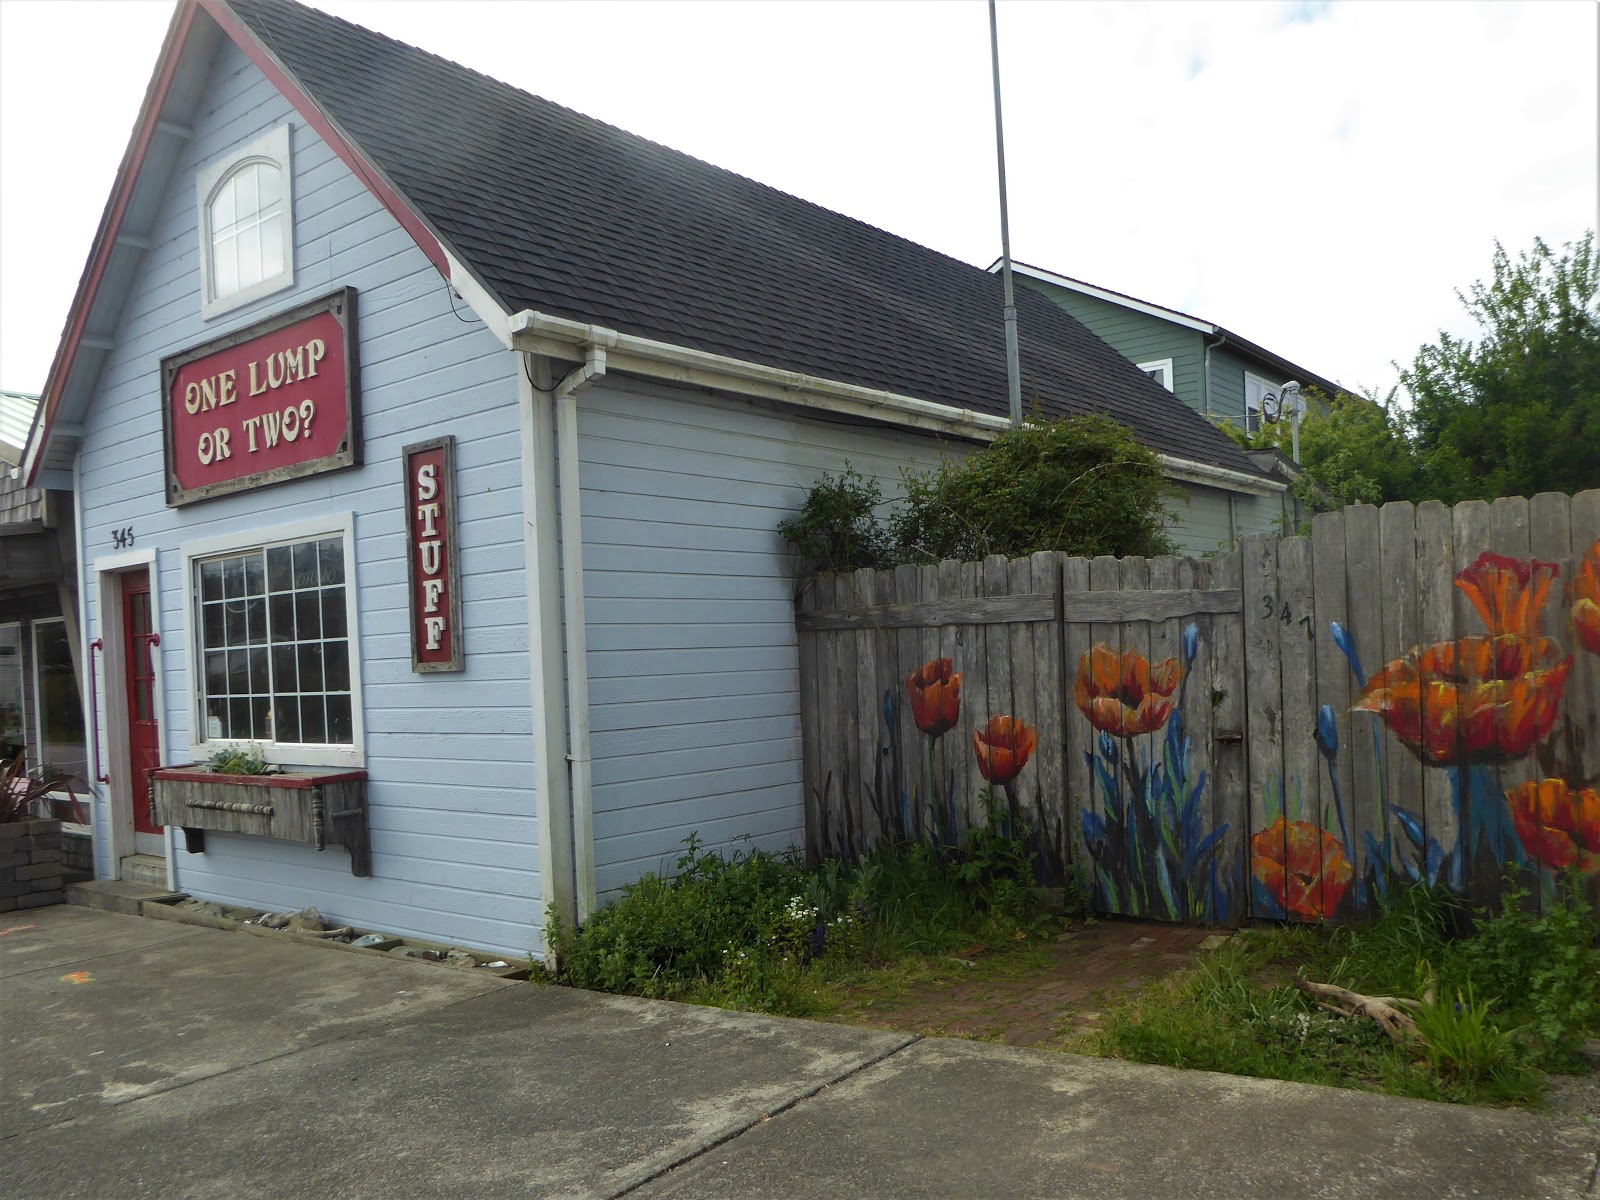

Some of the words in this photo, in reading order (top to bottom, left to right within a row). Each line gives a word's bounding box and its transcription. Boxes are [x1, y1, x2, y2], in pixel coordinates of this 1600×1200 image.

[185, 369, 238, 415] ONE
[248, 339, 327, 397] LUMP
[198, 427, 232, 466] OR
[243, 399, 316, 453] TWO?
[111, 525, 135, 550] 345
[417, 464, 446, 650] STUFF
[1261, 594, 1314, 642] 347
